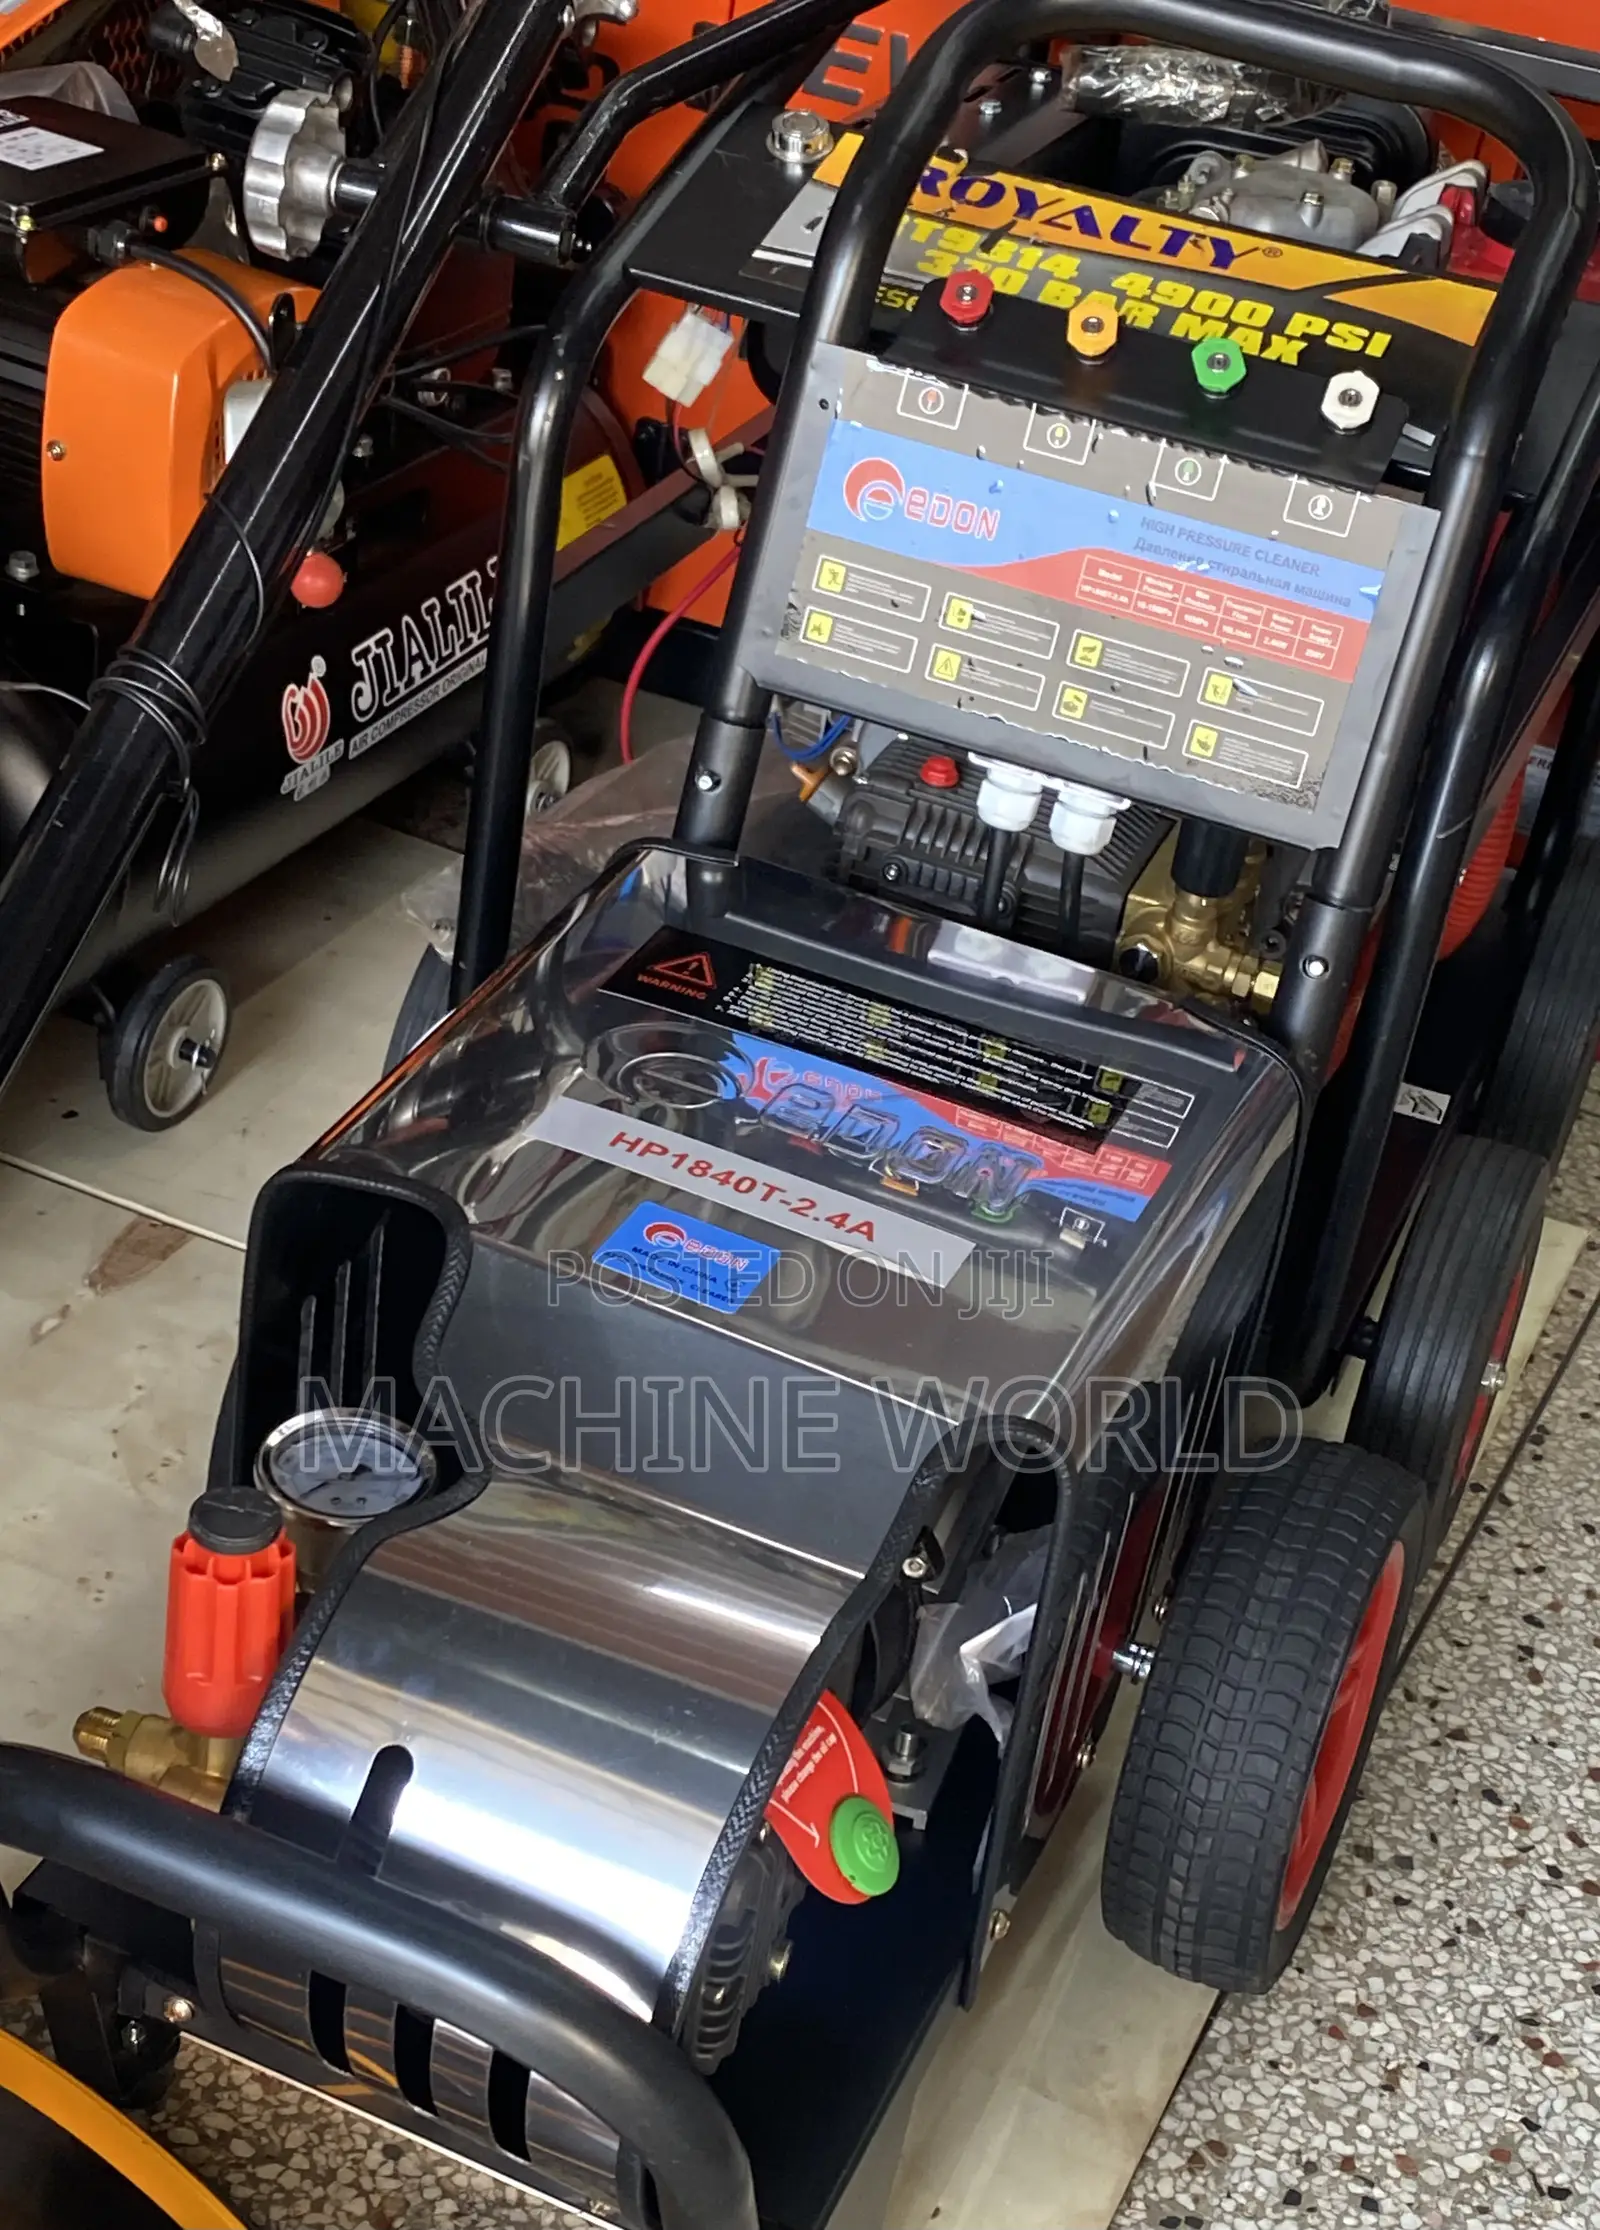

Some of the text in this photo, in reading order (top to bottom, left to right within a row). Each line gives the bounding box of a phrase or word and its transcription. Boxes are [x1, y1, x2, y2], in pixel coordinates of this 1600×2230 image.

[1111, 271, 1274, 328] 4900
[1284, 312, 1392, 358] PSI
[1169, 312, 1308, 366] MAX
[1141, 516, 1321, 578] HIGH PRESSURE CLEANER
[1209, 556, 1292, 592] стиральная
[1294, 582, 1353, 609] машина
[351, 556, 498, 722] JIALIL
[351, 734, 369, 754] AIR
[370, 682, 441, 743] COMPRESSOR
[637, 973, 709, 1000] WARNING
[608, 1131, 875, 1243] HP1840T-2.4A
[667, 1260, 681, 1270] IN
[682, 1265, 718, 1284] CHINA
